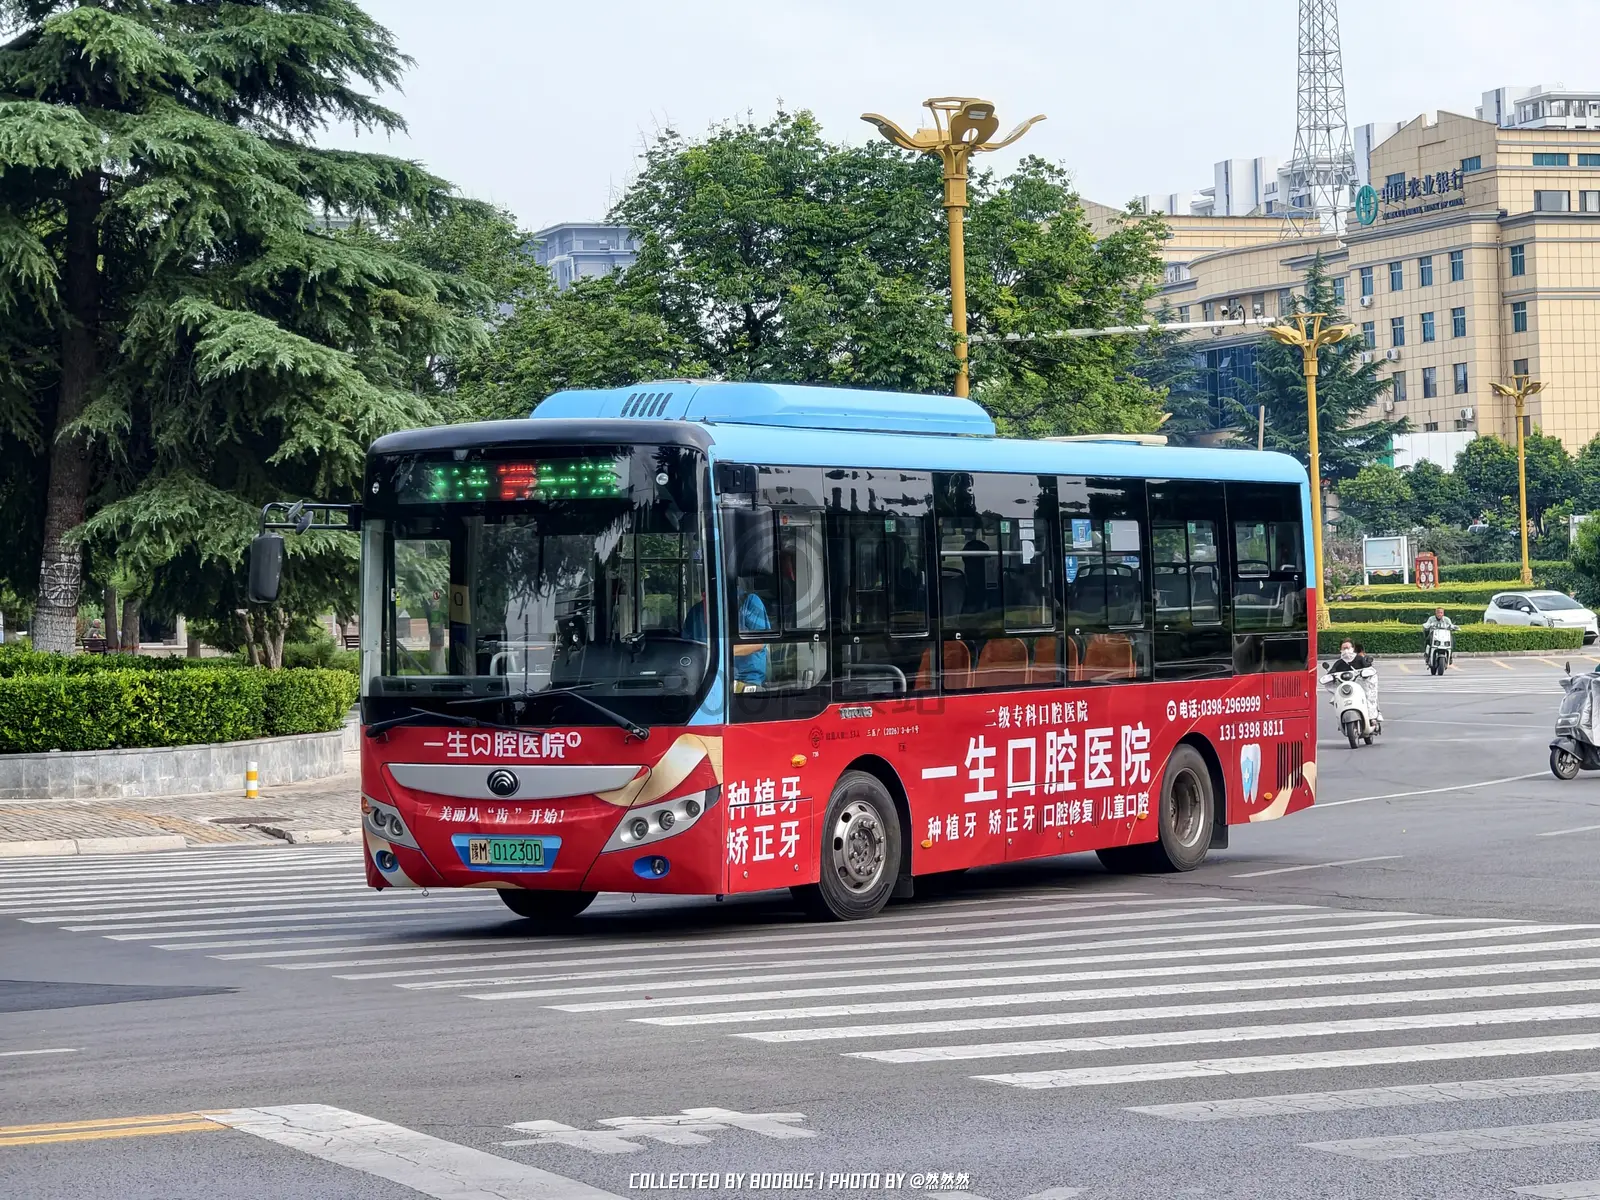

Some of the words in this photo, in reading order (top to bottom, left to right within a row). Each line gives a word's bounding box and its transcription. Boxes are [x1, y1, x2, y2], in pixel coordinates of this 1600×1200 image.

[1381, 168, 1464, 205] 中国农业银行
[984, 700, 1089, 729] 二级专科口腔医院
[1220, 723, 1236, 741] 131
[1239, 721, 1260, 739] 9398
[1262, 719, 1284, 737] 8811
[423, 730, 566, 758] 一生口腔医院
[921, 721, 1151, 804] 一生口腔医院
[727, 776, 801, 821] 种植牙
[927, 811, 977, 843] 种植牙
[988, 805, 1035, 835] 矫正牙
[1044, 798, 1094, 828] 口腔修复
[1100, 791, 1149, 821] 儿童口腔
[726, 820, 800, 866] 矫正牙
